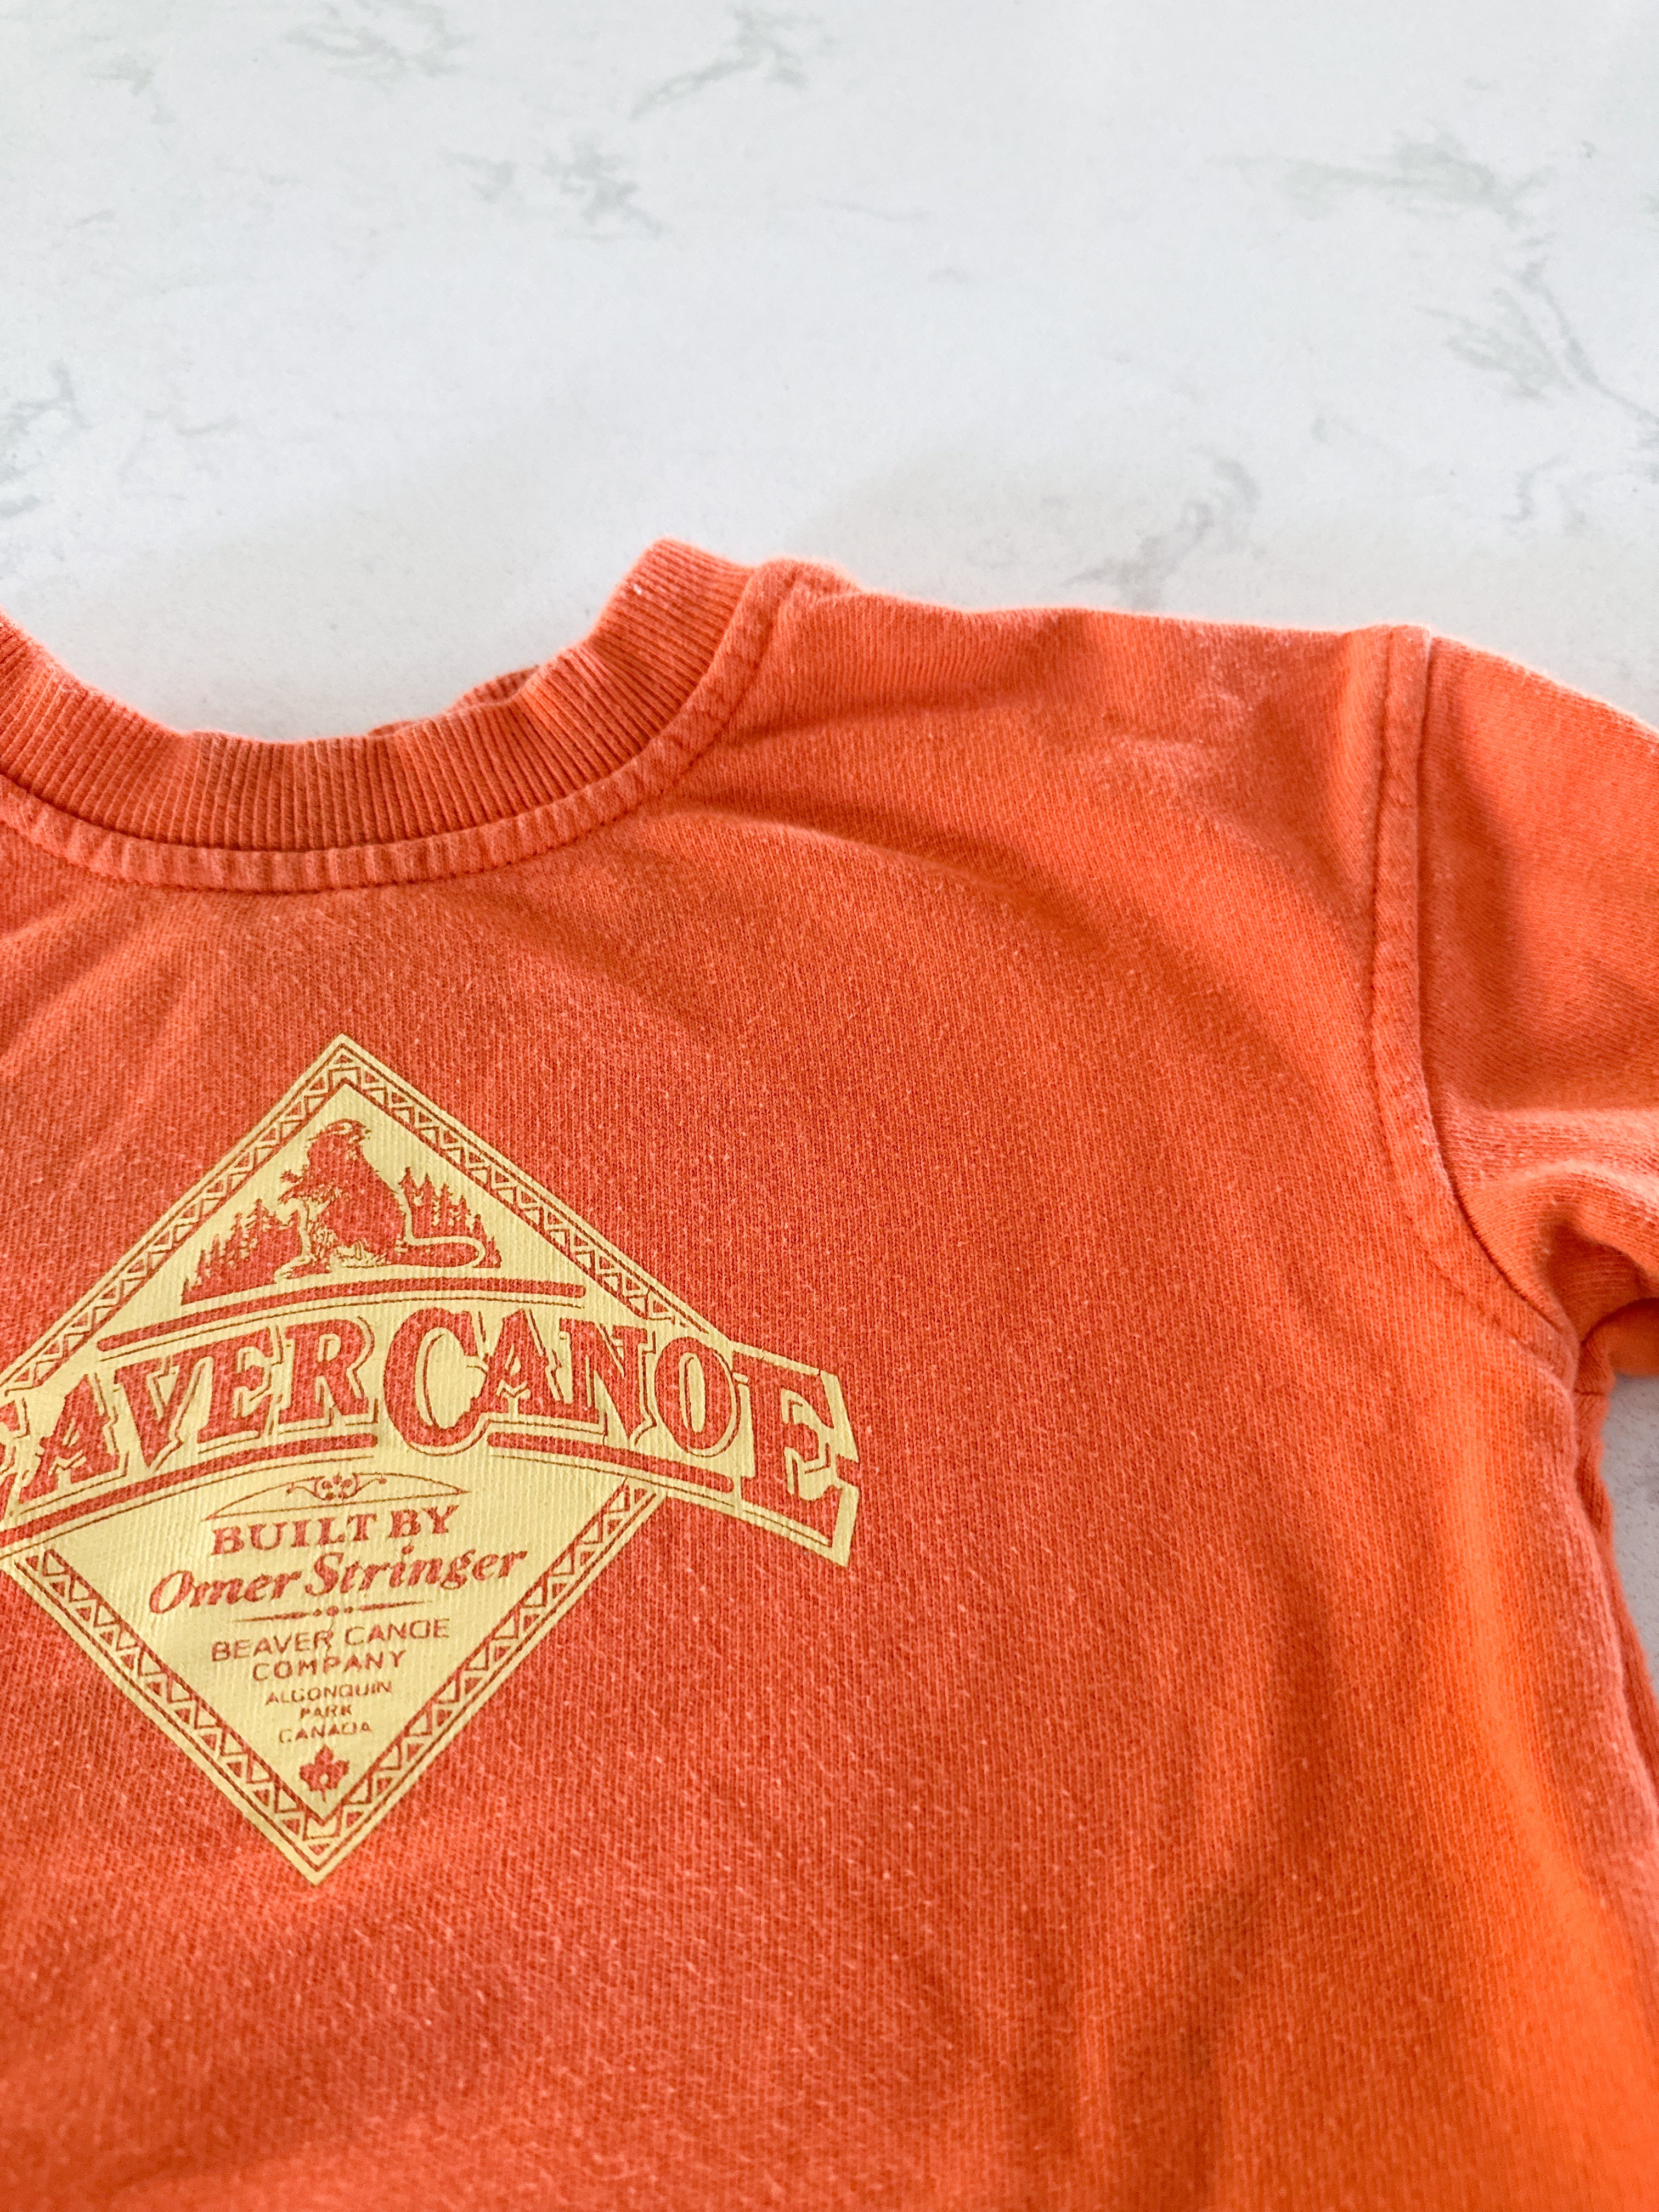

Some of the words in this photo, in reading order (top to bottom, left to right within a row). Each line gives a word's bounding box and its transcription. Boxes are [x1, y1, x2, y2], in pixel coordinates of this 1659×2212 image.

[383, 1308, 843, 1548] CANOE
[211, 1514, 377, 1556] BUILT
[387, 1505, 460, 1537] BY
[148, 1570, 302, 1614] Omer
[304, 1543, 528, 1590] Stringer
[211, 1629, 334, 1661] BEAVER
[344, 1618, 450, 1643] CANOE
[252, 1650, 407, 1682] COMPANY
[265, 1681, 392, 1706] ALGONQUIN
[300, 1705, 352, 1718] PARK
[279, 1722, 374, 1743] CANADA
